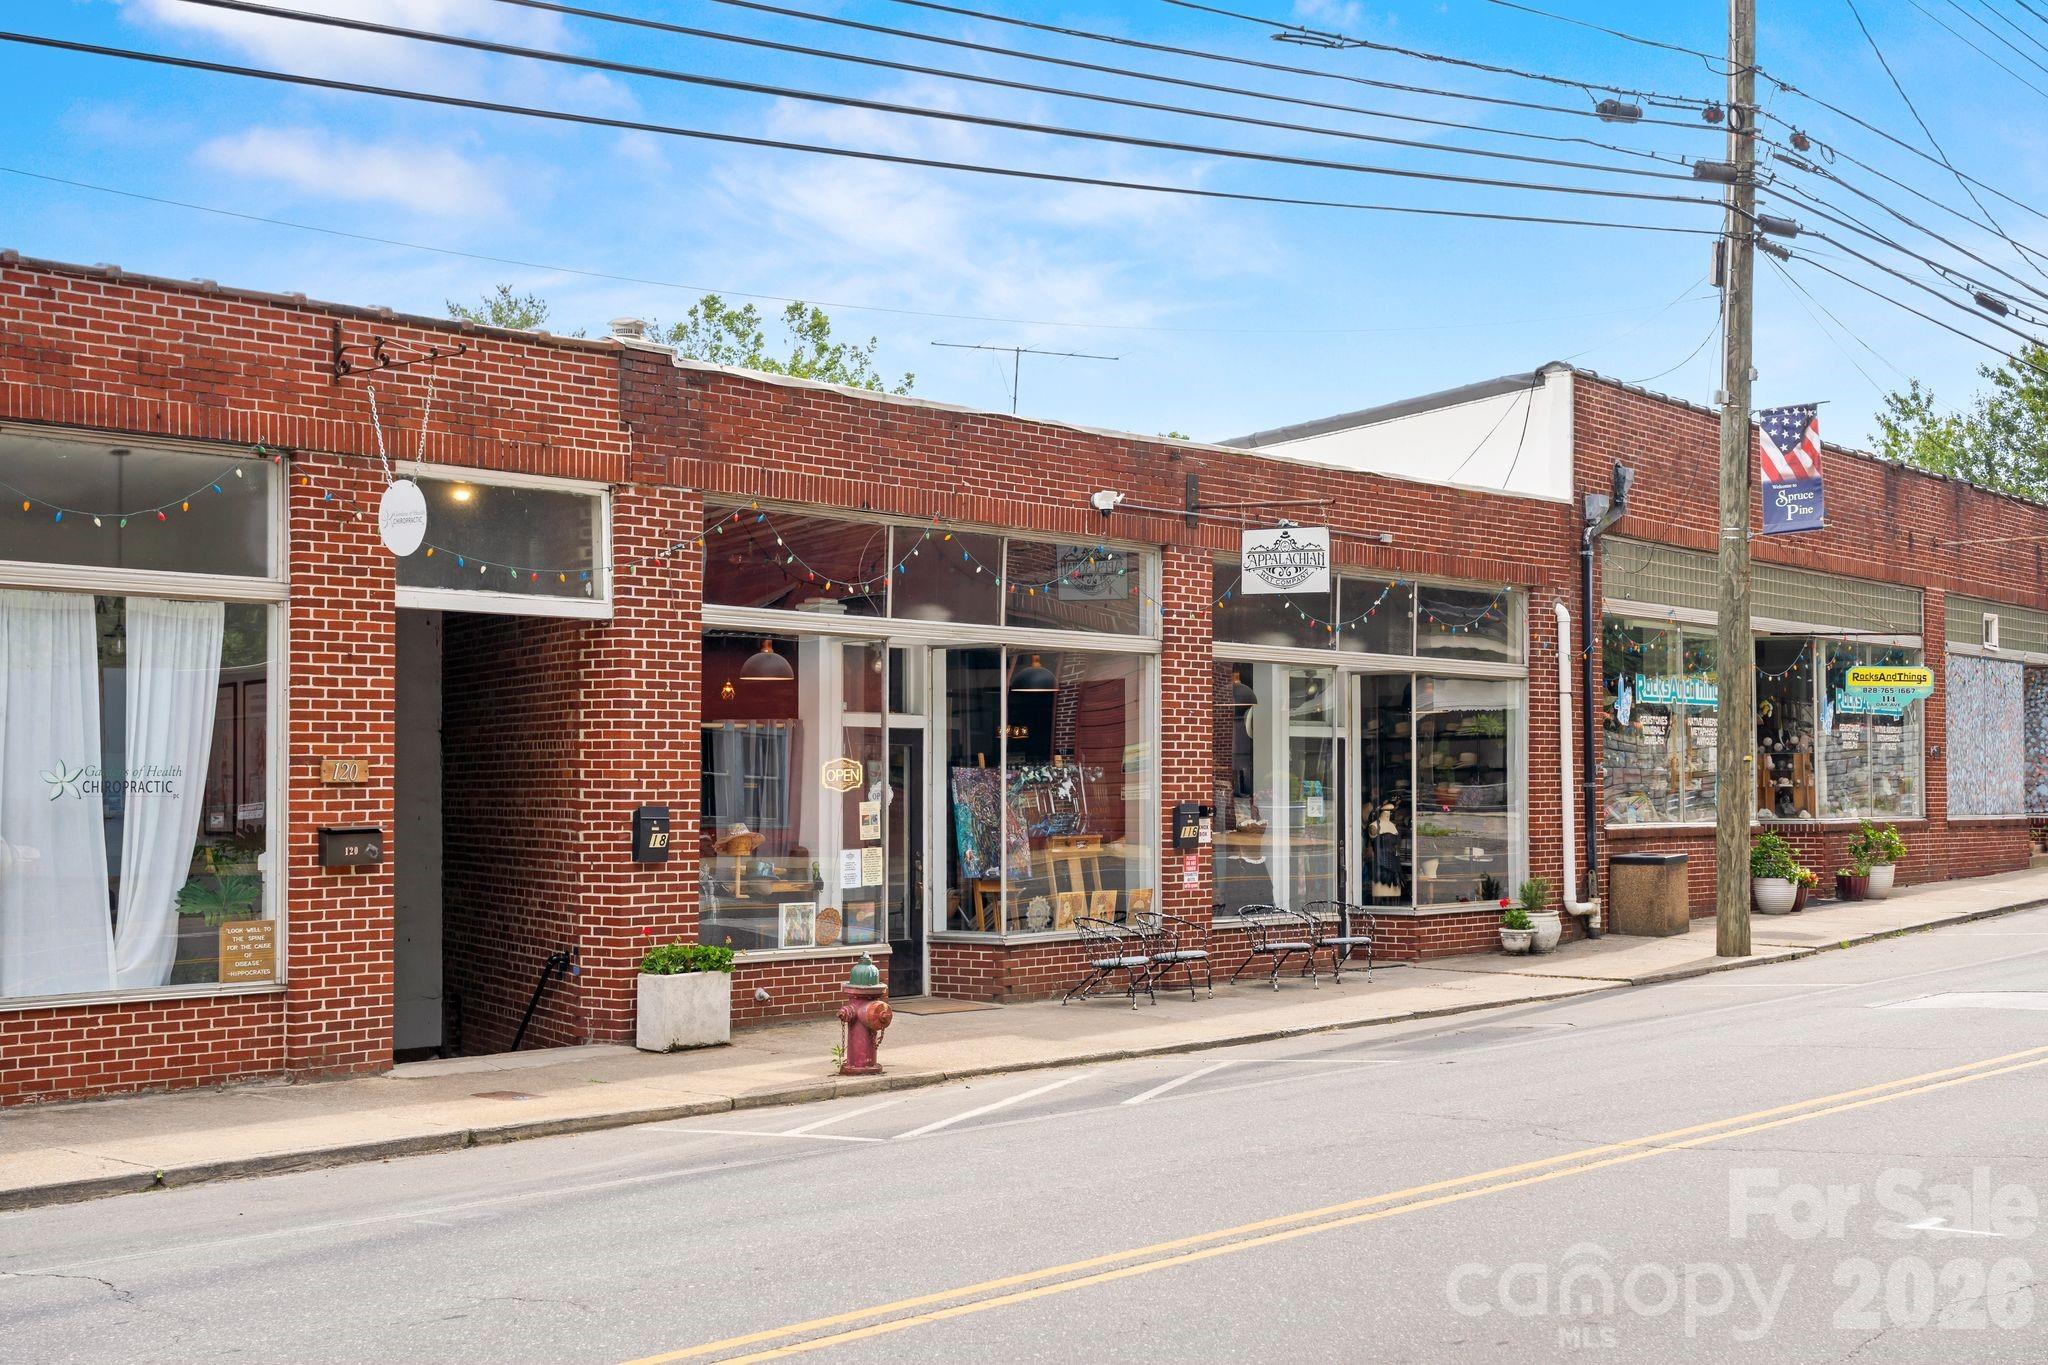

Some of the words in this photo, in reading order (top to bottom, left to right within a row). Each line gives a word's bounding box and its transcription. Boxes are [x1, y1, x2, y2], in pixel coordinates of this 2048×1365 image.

[1775, 489, 1814, 507] Spruce
[1786, 504, 1814, 521] Pine
[1243, 552, 1326, 568] APPALACHIAN
[1260, 571, 1275, 583] HAT
[1275, 570, 1311, 586] COMPANY
[1852, 672, 1928, 685] RocksAndThings
[132, 765, 146, 778] of
[146, 764, 183, 777] Health
[333, 762, 358, 781] 120
[826, 768, 860, 782] OPEN
[82, 780, 173, 793] CHIROPRACTIC
[1182, 826, 1198, 837] 116
[345, 846, 359, 856] 120
